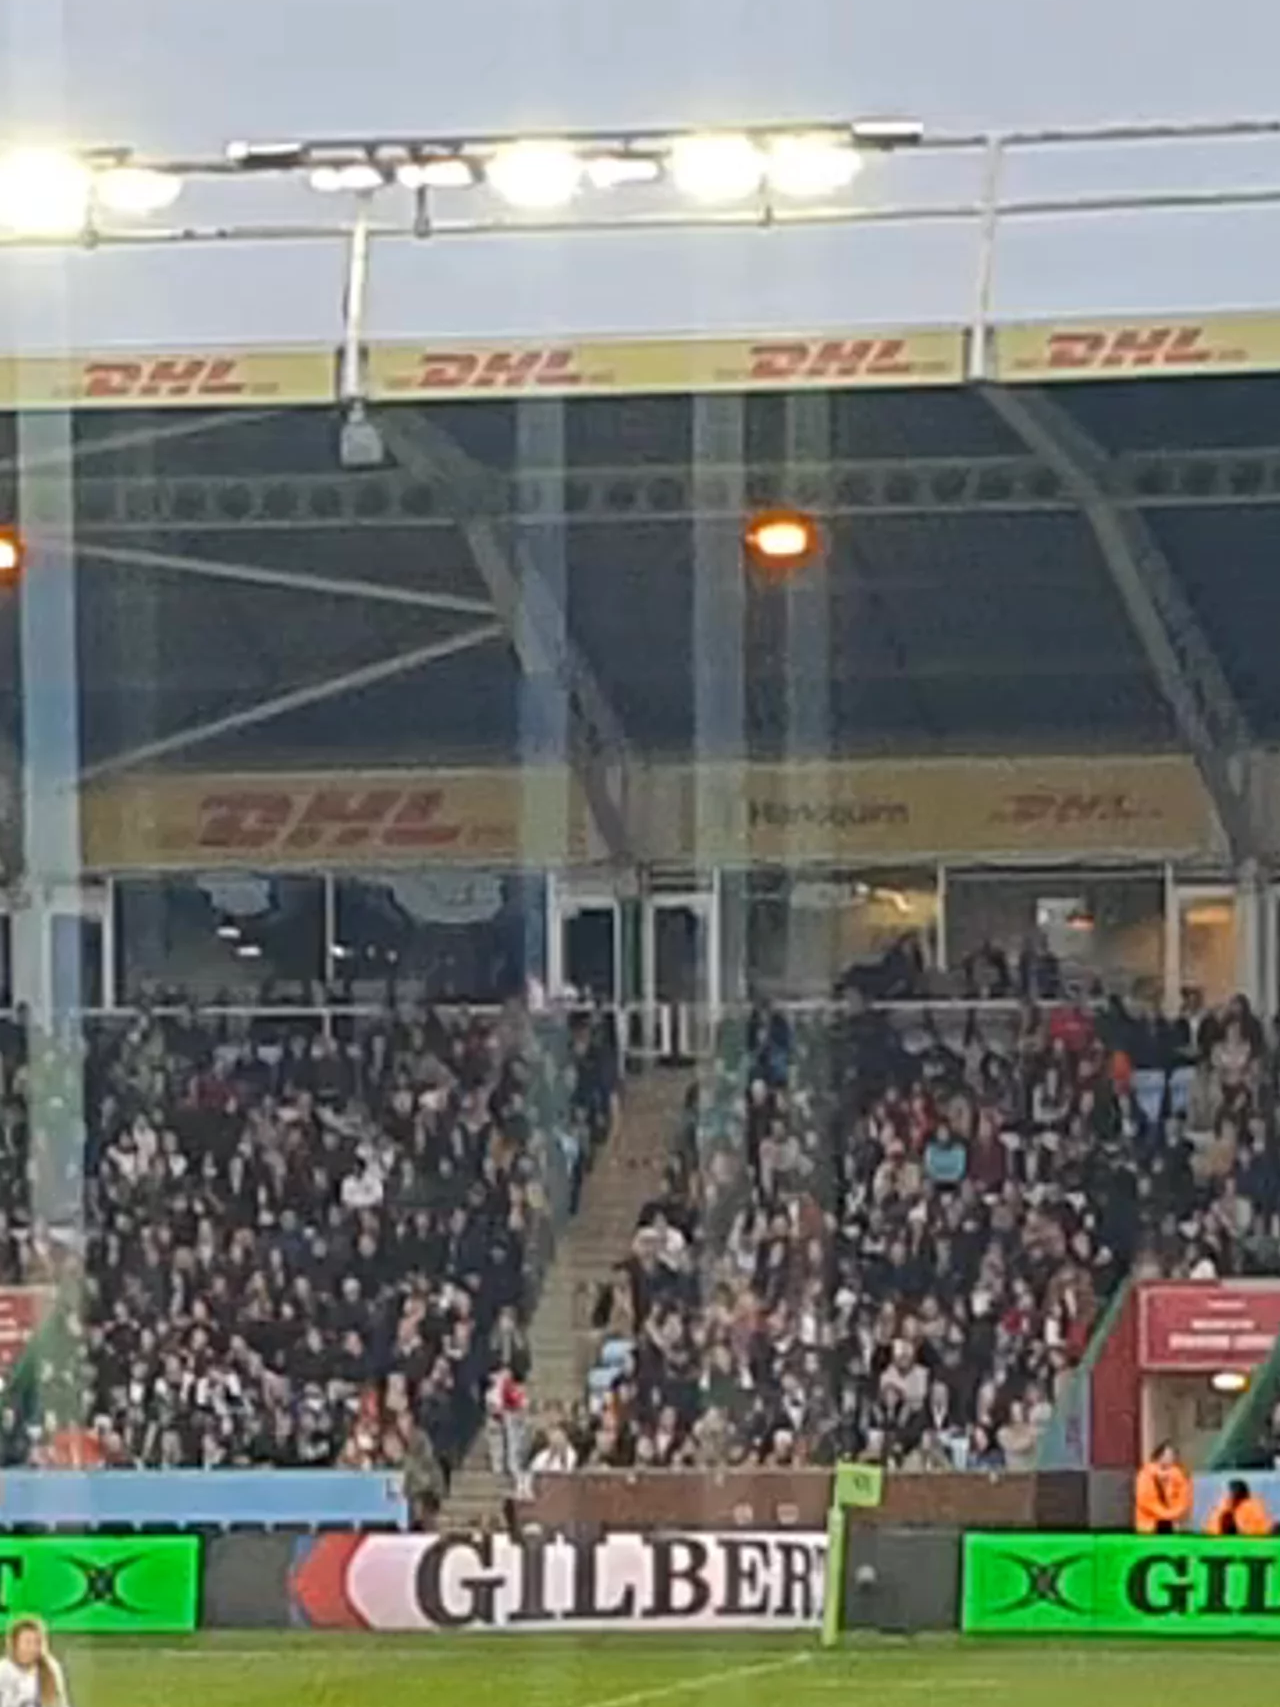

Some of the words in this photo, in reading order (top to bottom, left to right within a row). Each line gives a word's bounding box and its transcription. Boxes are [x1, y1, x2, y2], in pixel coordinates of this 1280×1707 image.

[750, 340, 910, 378] DHL
[1047, 329, 1212, 366] DHL
[85, 362, 243, 396] DHL
[418, 353, 582, 388] DHL
[200, 791, 460, 848] DHL
